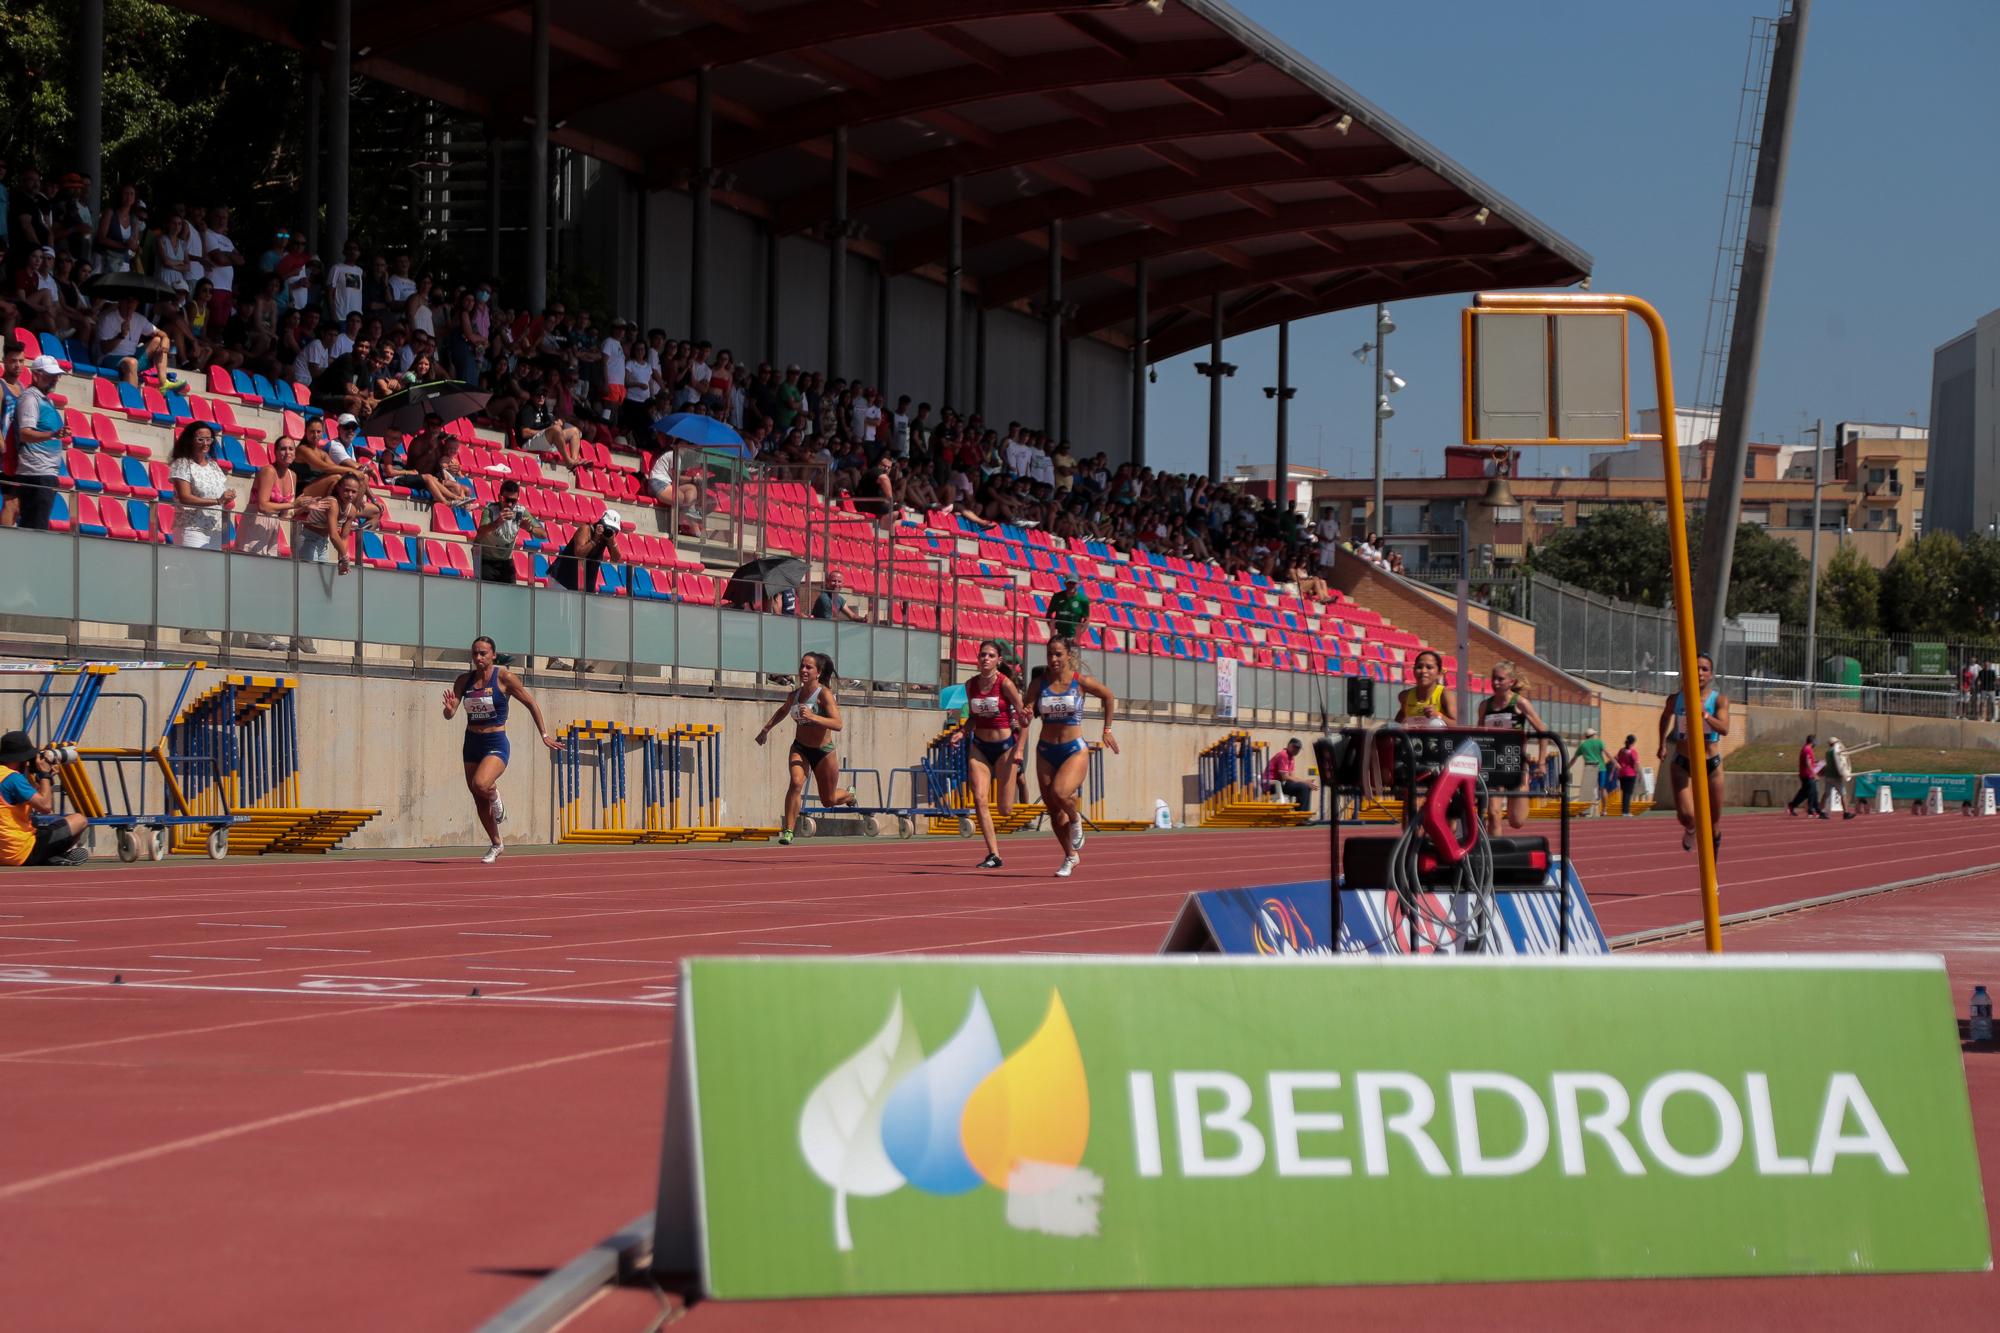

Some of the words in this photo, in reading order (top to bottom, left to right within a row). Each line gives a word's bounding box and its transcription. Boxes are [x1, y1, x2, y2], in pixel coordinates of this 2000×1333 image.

[1049, 703, 1067, 712] 103
[1905, 774, 1929, 784] rural
[1931, 776, 1966, 785] torrent
[1128, 1069, 1909, 1178] IBERDROLA
